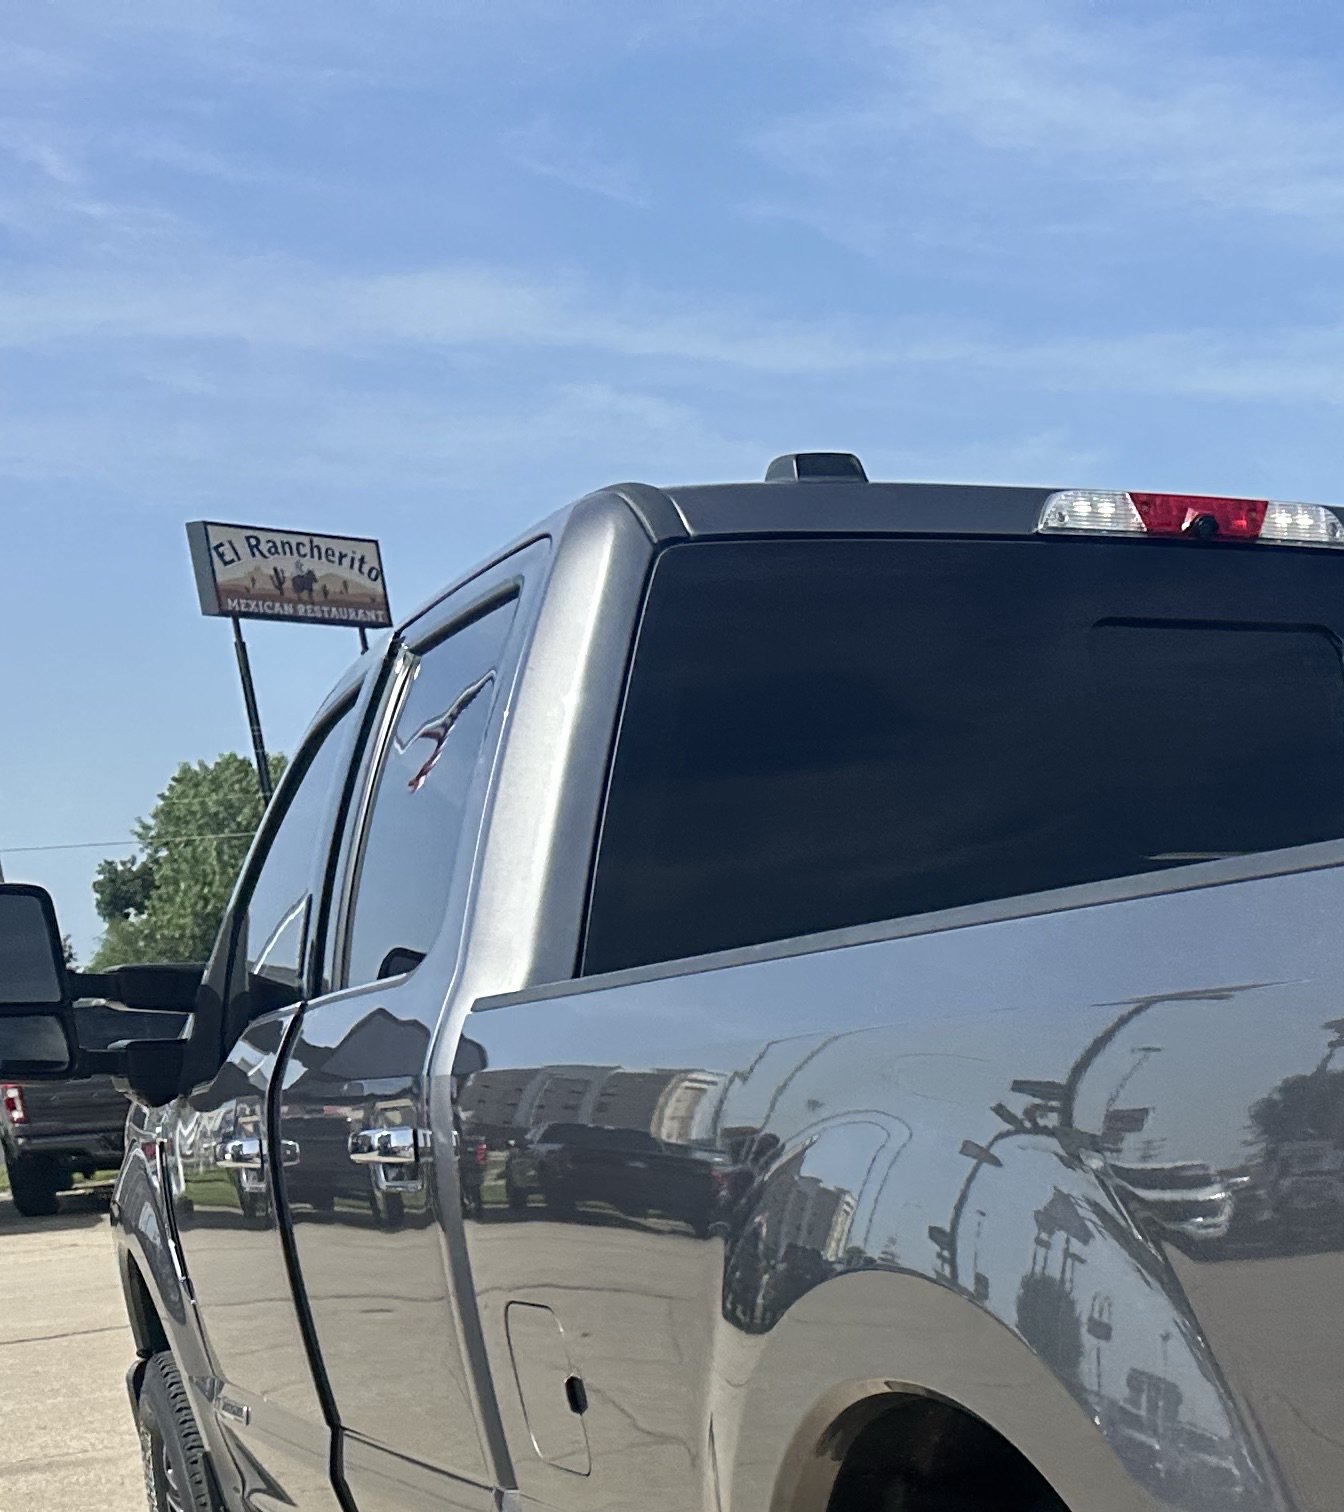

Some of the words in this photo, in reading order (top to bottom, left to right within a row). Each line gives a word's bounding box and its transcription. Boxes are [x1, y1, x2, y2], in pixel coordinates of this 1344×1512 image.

[213, 540, 240, 567] El
[244, 535, 380, 582] Rancherito
[227, 597, 294, 615] MEXICAN
[297, 603, 385, 623] RESTAURANT
